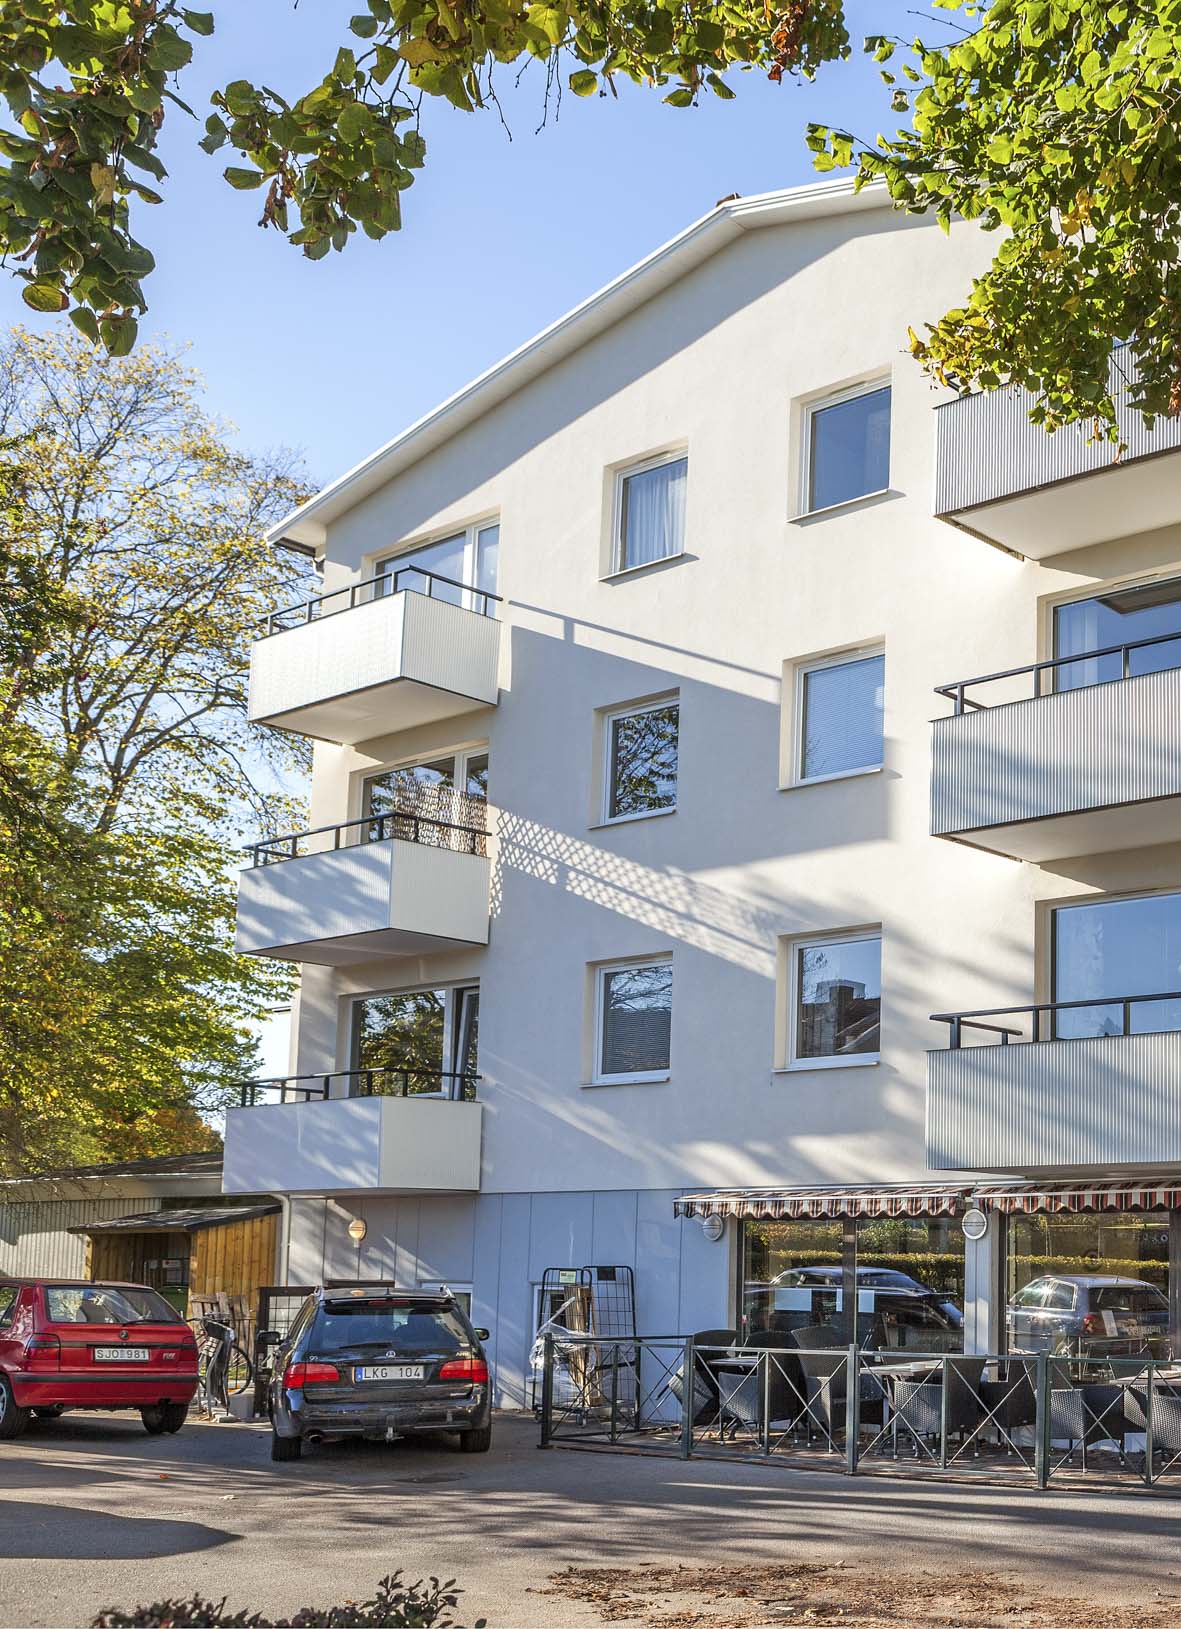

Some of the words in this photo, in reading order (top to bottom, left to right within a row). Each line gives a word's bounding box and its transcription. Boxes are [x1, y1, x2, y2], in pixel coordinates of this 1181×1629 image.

[97, 1349, 119, 1359] SJO
[126, 1350, 146, 1359] 981
[364, 1367, 388, 1378] LKG
[400, 1367, 421, 1378] 104
